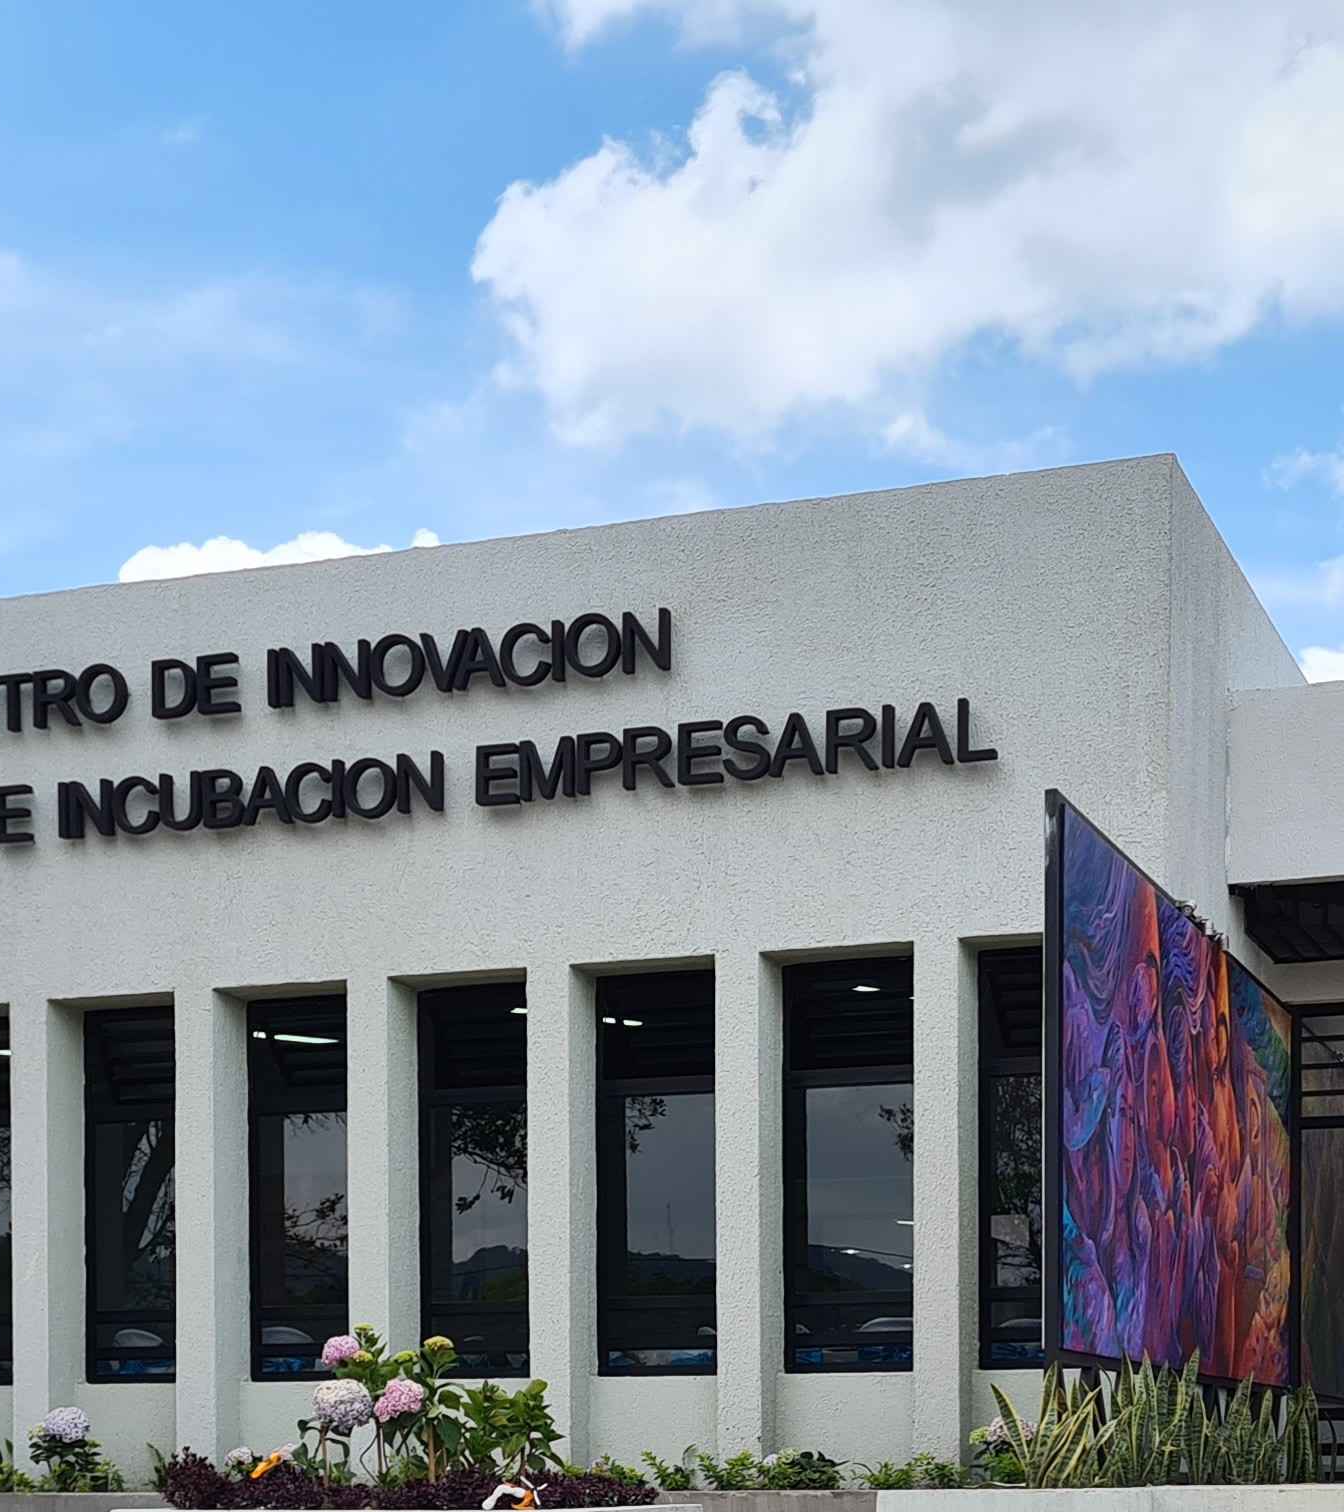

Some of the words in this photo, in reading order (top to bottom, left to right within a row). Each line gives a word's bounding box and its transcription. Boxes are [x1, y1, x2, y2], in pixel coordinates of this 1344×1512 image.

[151, 651, 242, 720] DE
[267, 607, 671, 709] INNOVACION
[58, 750, 445, 840] INCUBACION
[475, 698, 999, 807] EMPRESARIAL
